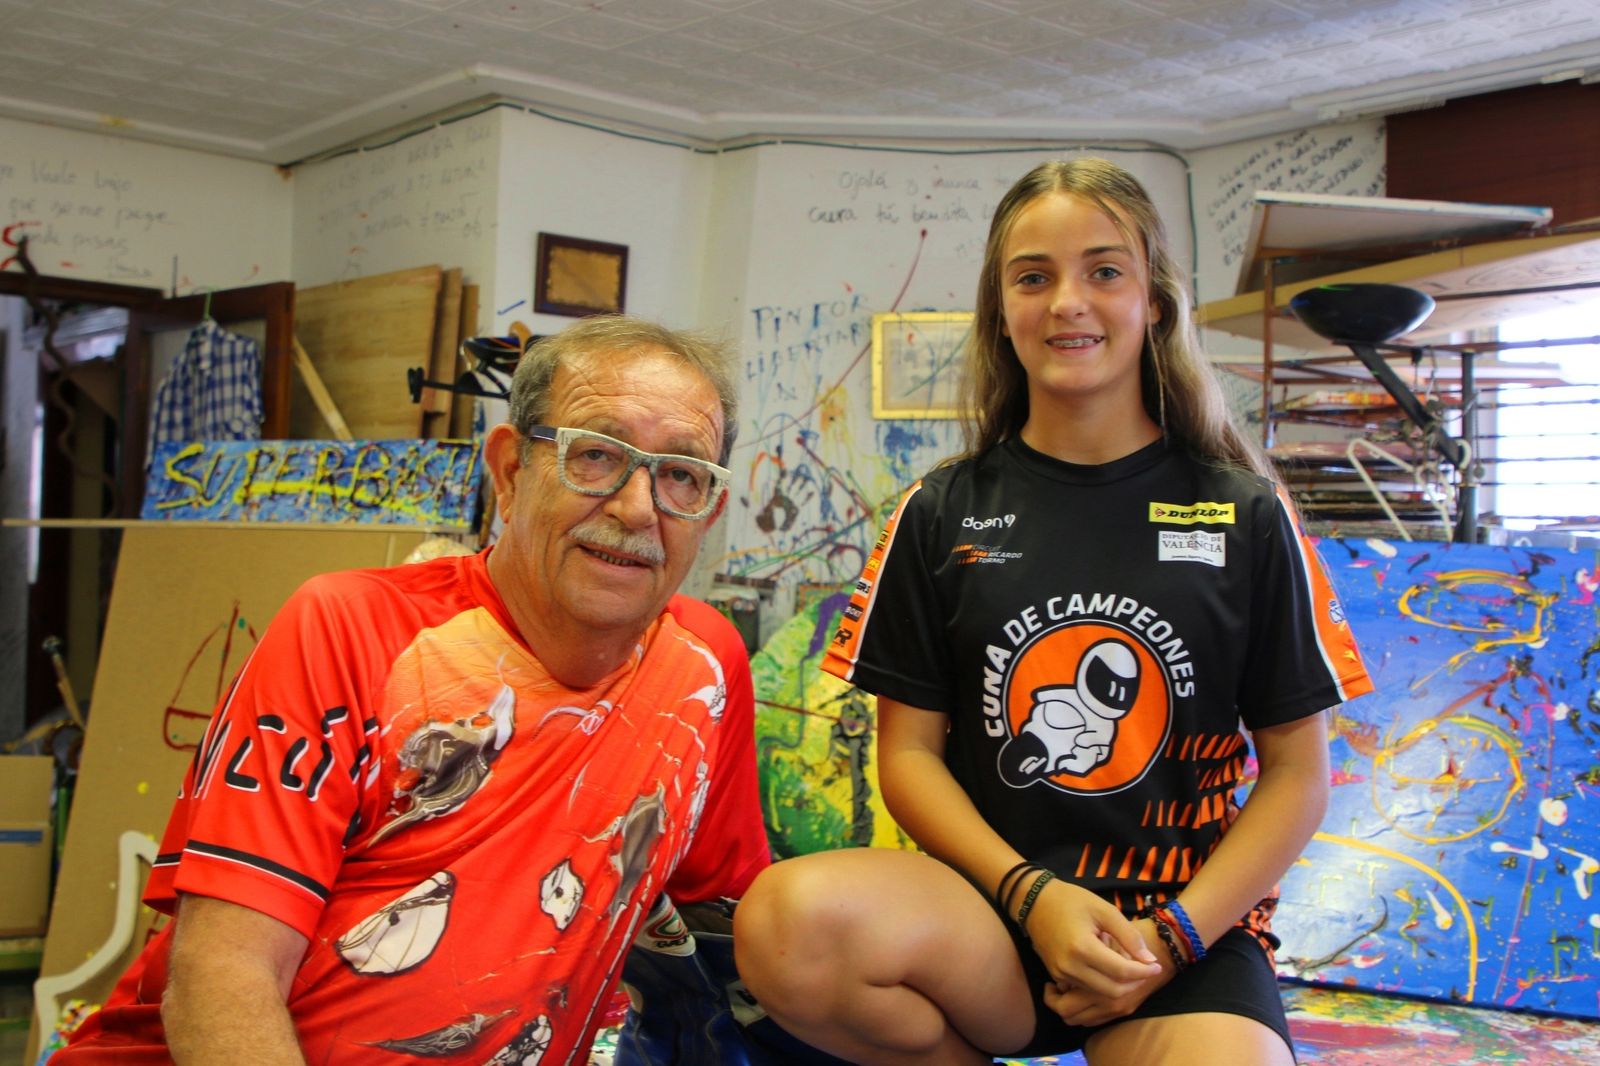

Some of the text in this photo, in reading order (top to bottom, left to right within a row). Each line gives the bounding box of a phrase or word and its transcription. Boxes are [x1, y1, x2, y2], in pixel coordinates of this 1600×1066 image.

[1167, 508, 1229, 519] DUNLOP
[987, 551, 1023, 559] RICARDO
[983, 593, 1195, 738] CUNA DE CAMPEONES
